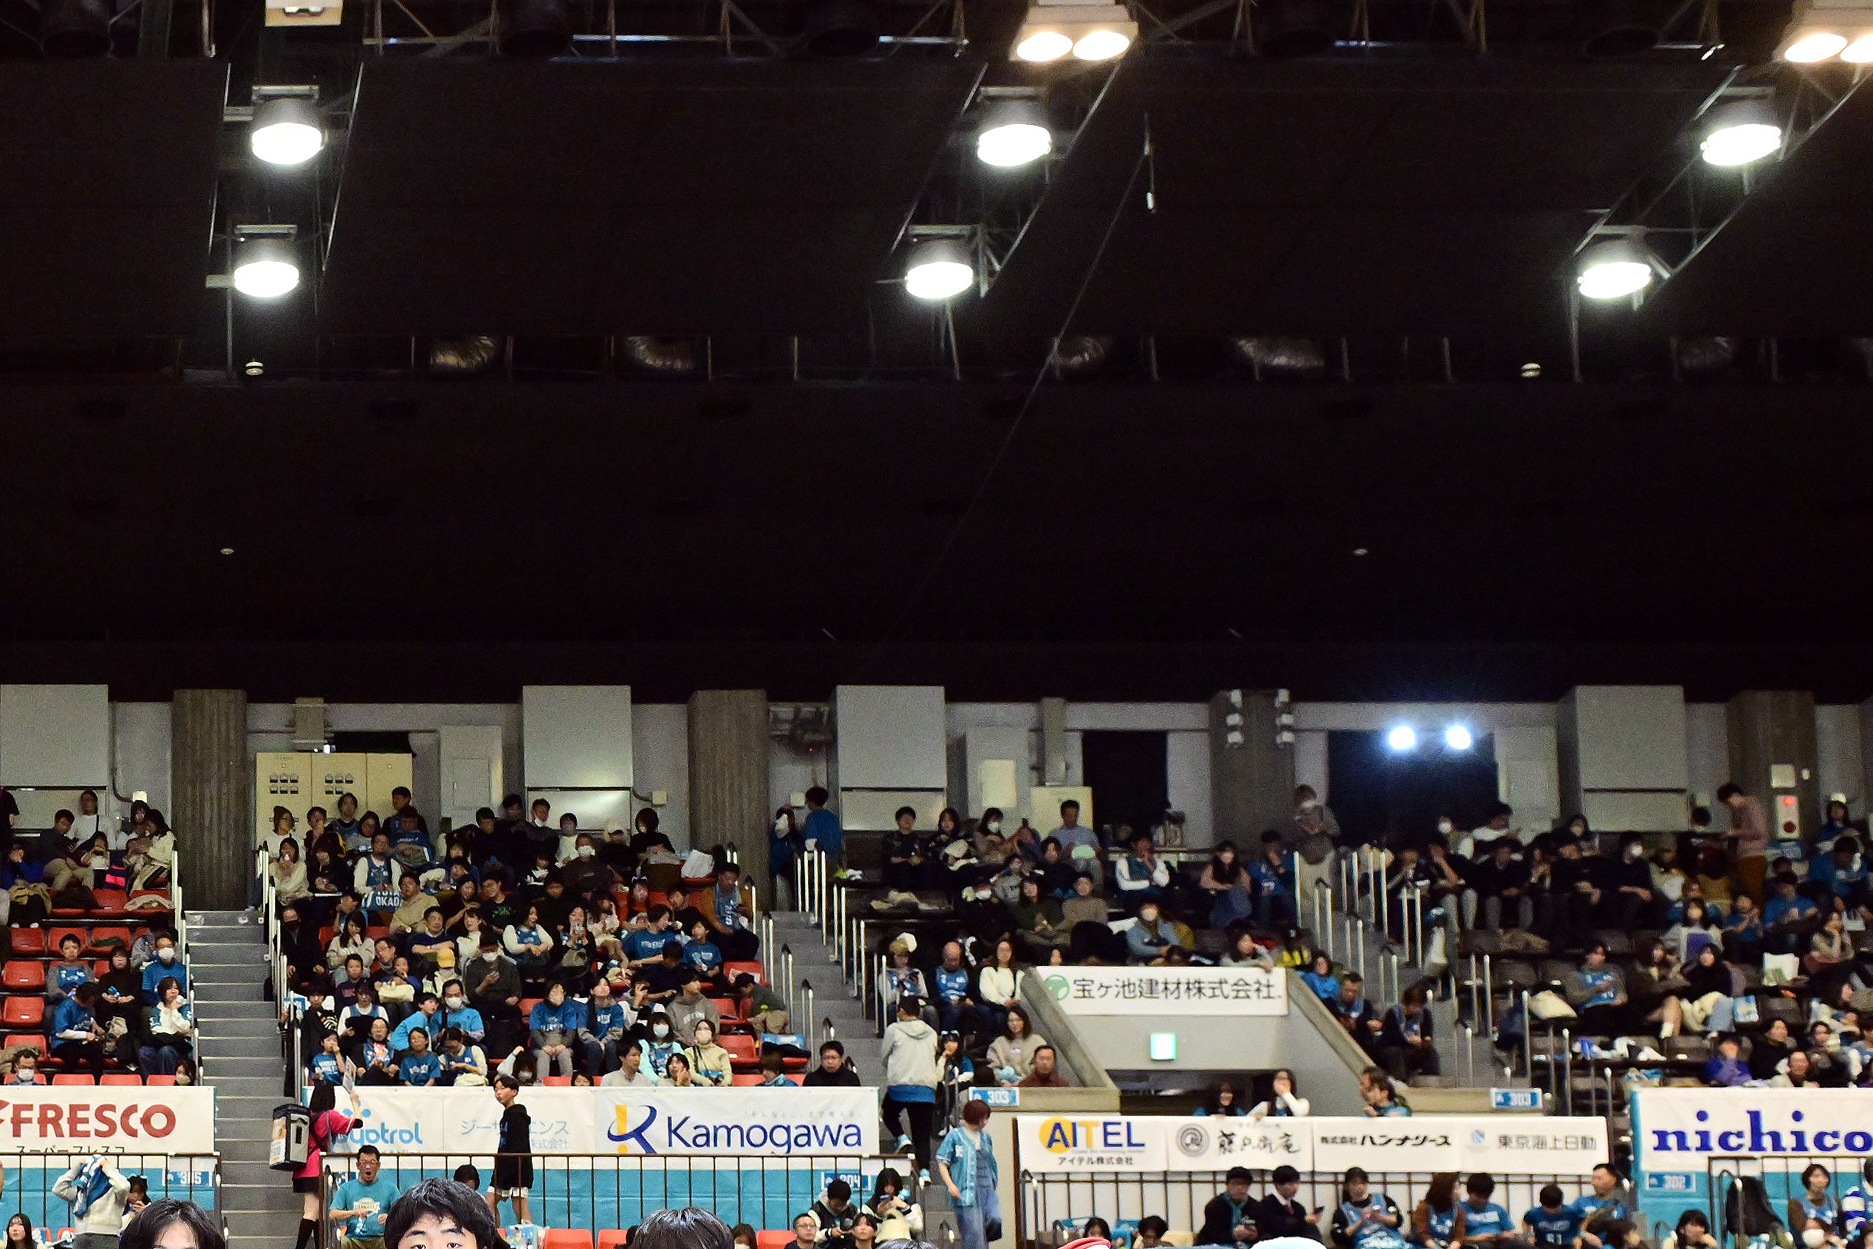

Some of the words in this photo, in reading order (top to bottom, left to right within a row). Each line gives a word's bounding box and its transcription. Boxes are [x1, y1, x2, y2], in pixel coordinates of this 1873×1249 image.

[987, 1090, 1010, 1104] 303
[10, 1103, 177, 1139] FRESCO
[1652, 1110, 1873, 1152] nichico
[667, 1115, 863, 1154] Kamogawa
[1046, 1121, 1146, 1148] AITEL
[1360, 1134, 1452, 1147] ハンナリース
[1497, 1134, 1597, 1151] 東京海上日動
[1057, 1156, 1134, 1166] アイテル株式会社
